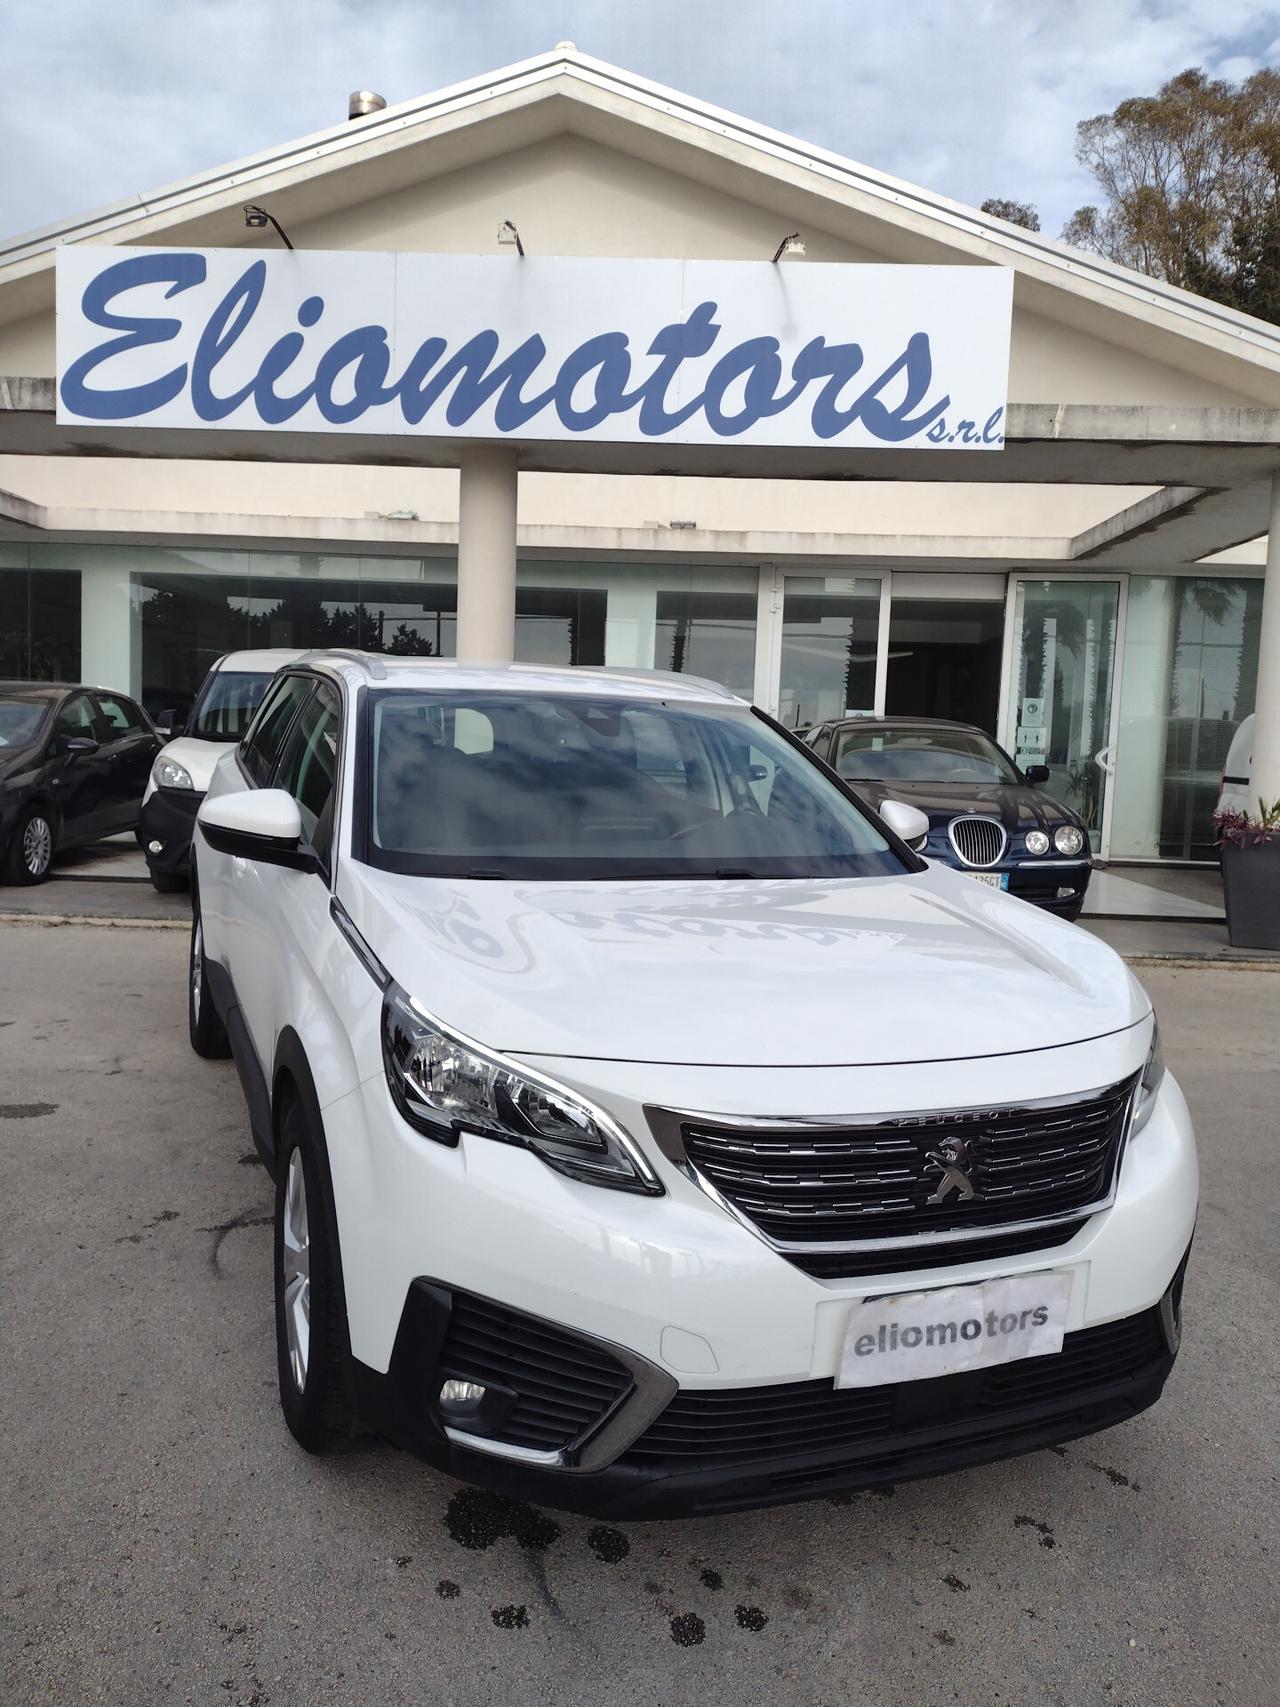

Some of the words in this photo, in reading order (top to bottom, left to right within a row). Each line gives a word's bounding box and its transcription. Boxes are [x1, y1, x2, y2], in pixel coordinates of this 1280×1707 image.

[60, 253, 951, 442] Eliomotors
[926, 406, 1005, 444] s.r.l.
[898, 1109, 1014, 1127] PEUGEOT
[854, 1305, 1049, 1357] eliomotors
